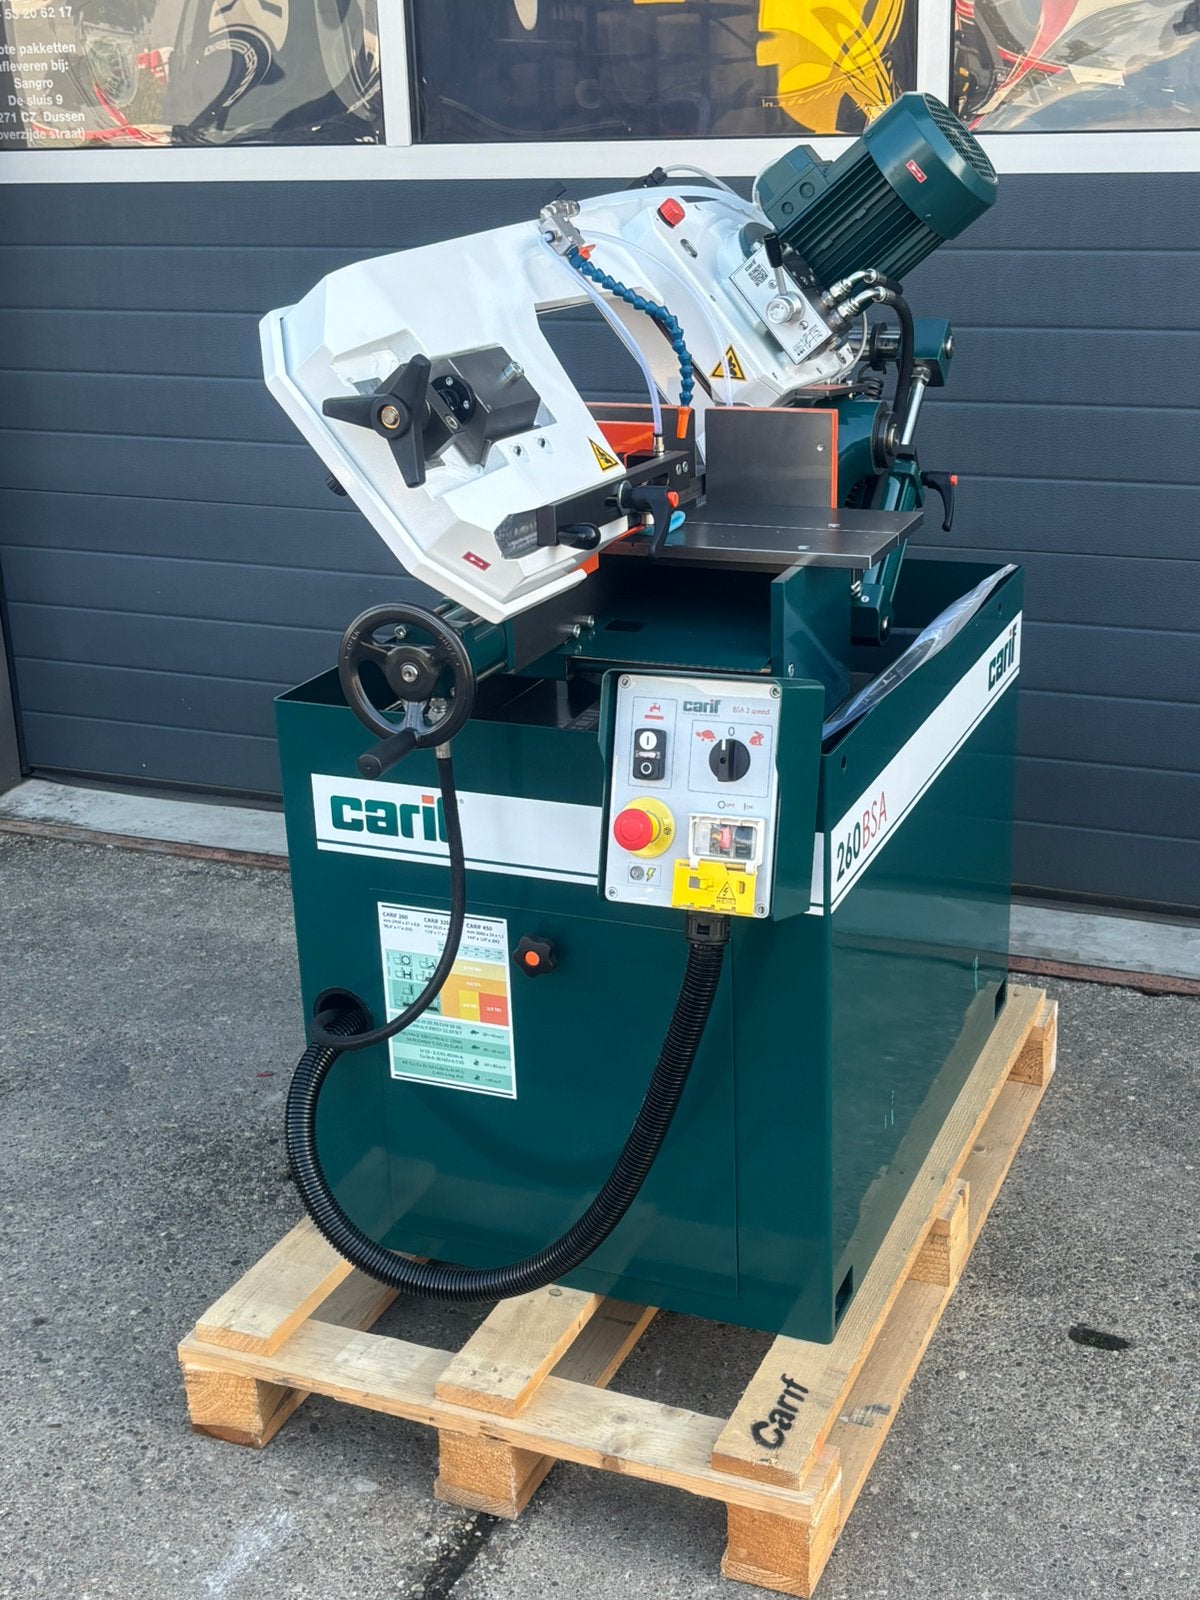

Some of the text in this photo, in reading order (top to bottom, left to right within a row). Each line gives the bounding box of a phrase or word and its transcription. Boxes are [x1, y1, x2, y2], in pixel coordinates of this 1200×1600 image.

[23, 8, 37, 18] 20
[40, 7, 55, 18] 62
[59, 6, 72, 17] 17
[20, 42, 76, 56] pakketten
[51, 59, 69, 72] bij:
[13, 78, 54, 90] Sangro
[8, 94, 64, 106] De sluis 9
[20, 111, 36, 122] CZ
[43, 112, 85, 122] Dussen
[49, 127, 86, 141] straat)
[987, 624, 1018, 692] carif
[682, 699, 722, 714] carif
[751, 1372, 809, 1450] Carif
